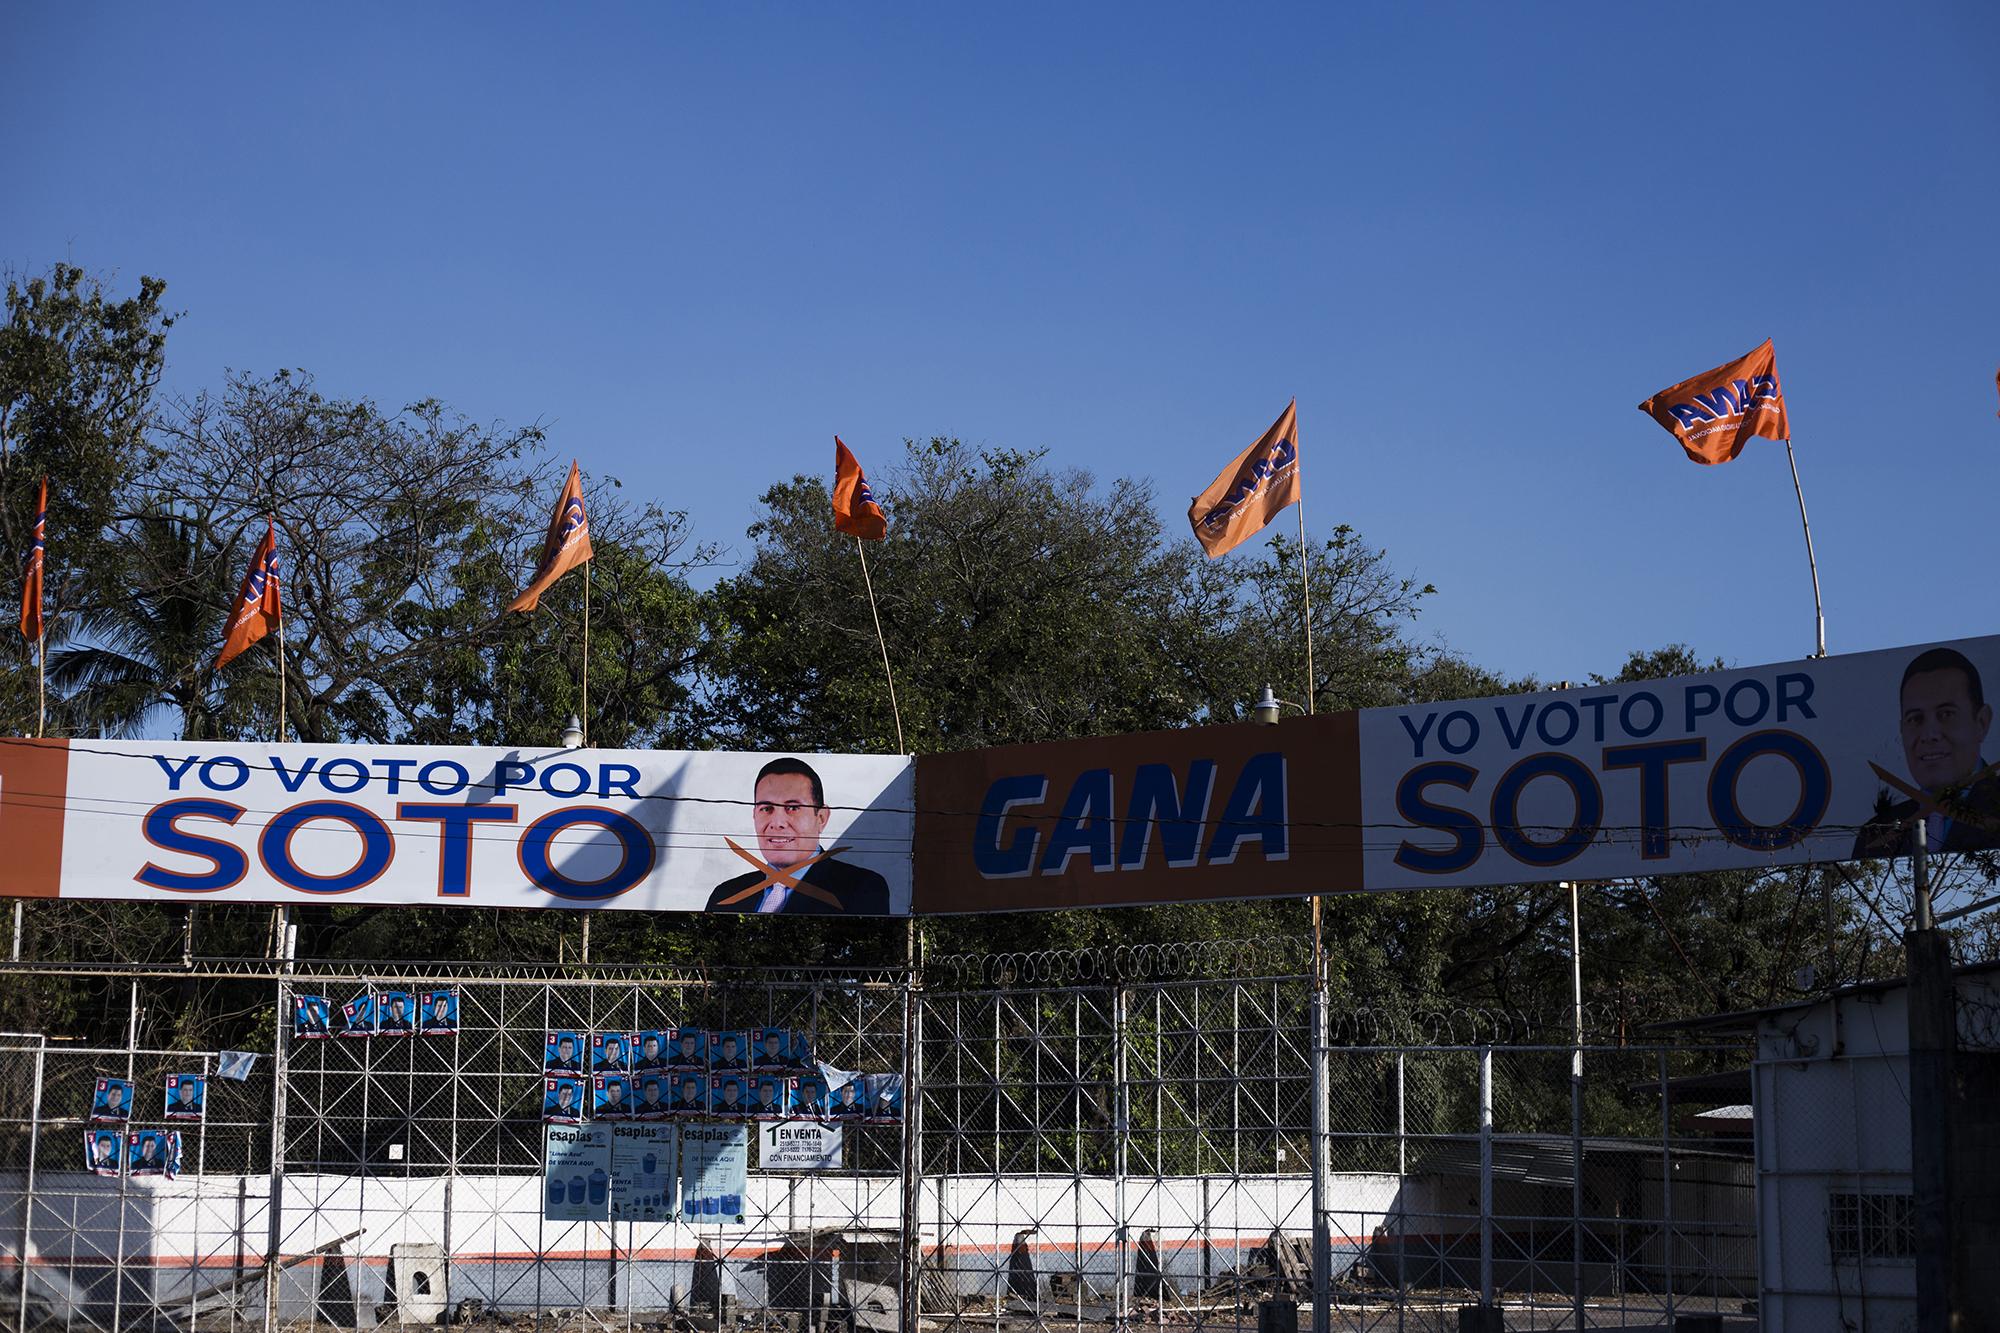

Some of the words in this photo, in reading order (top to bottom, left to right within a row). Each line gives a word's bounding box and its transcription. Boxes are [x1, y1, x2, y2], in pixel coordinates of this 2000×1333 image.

[1398, 710, 1480, 758] YO
[1494, 690, 1666, 749] VOTO
[1684, 673, 1818, 729] POR
[152, 755, 250, 791] YO
[268, 757, 470, 796] VOTO
[495, 762, 642, 801] POR
[972, 751, 1290, 880] GANA
[1392, 728, 1832, 875] SOTO
[133, 796, 656, 901] SOTO
[549, 1130, 592, 1144] esaplas
[614, 1126, 657, 1139] esaplas
[684, 1128, 729, 1143] esaplas
[780, 1129, 791, 1139] EN
[794, 1129, 822, 1139] VENTA
